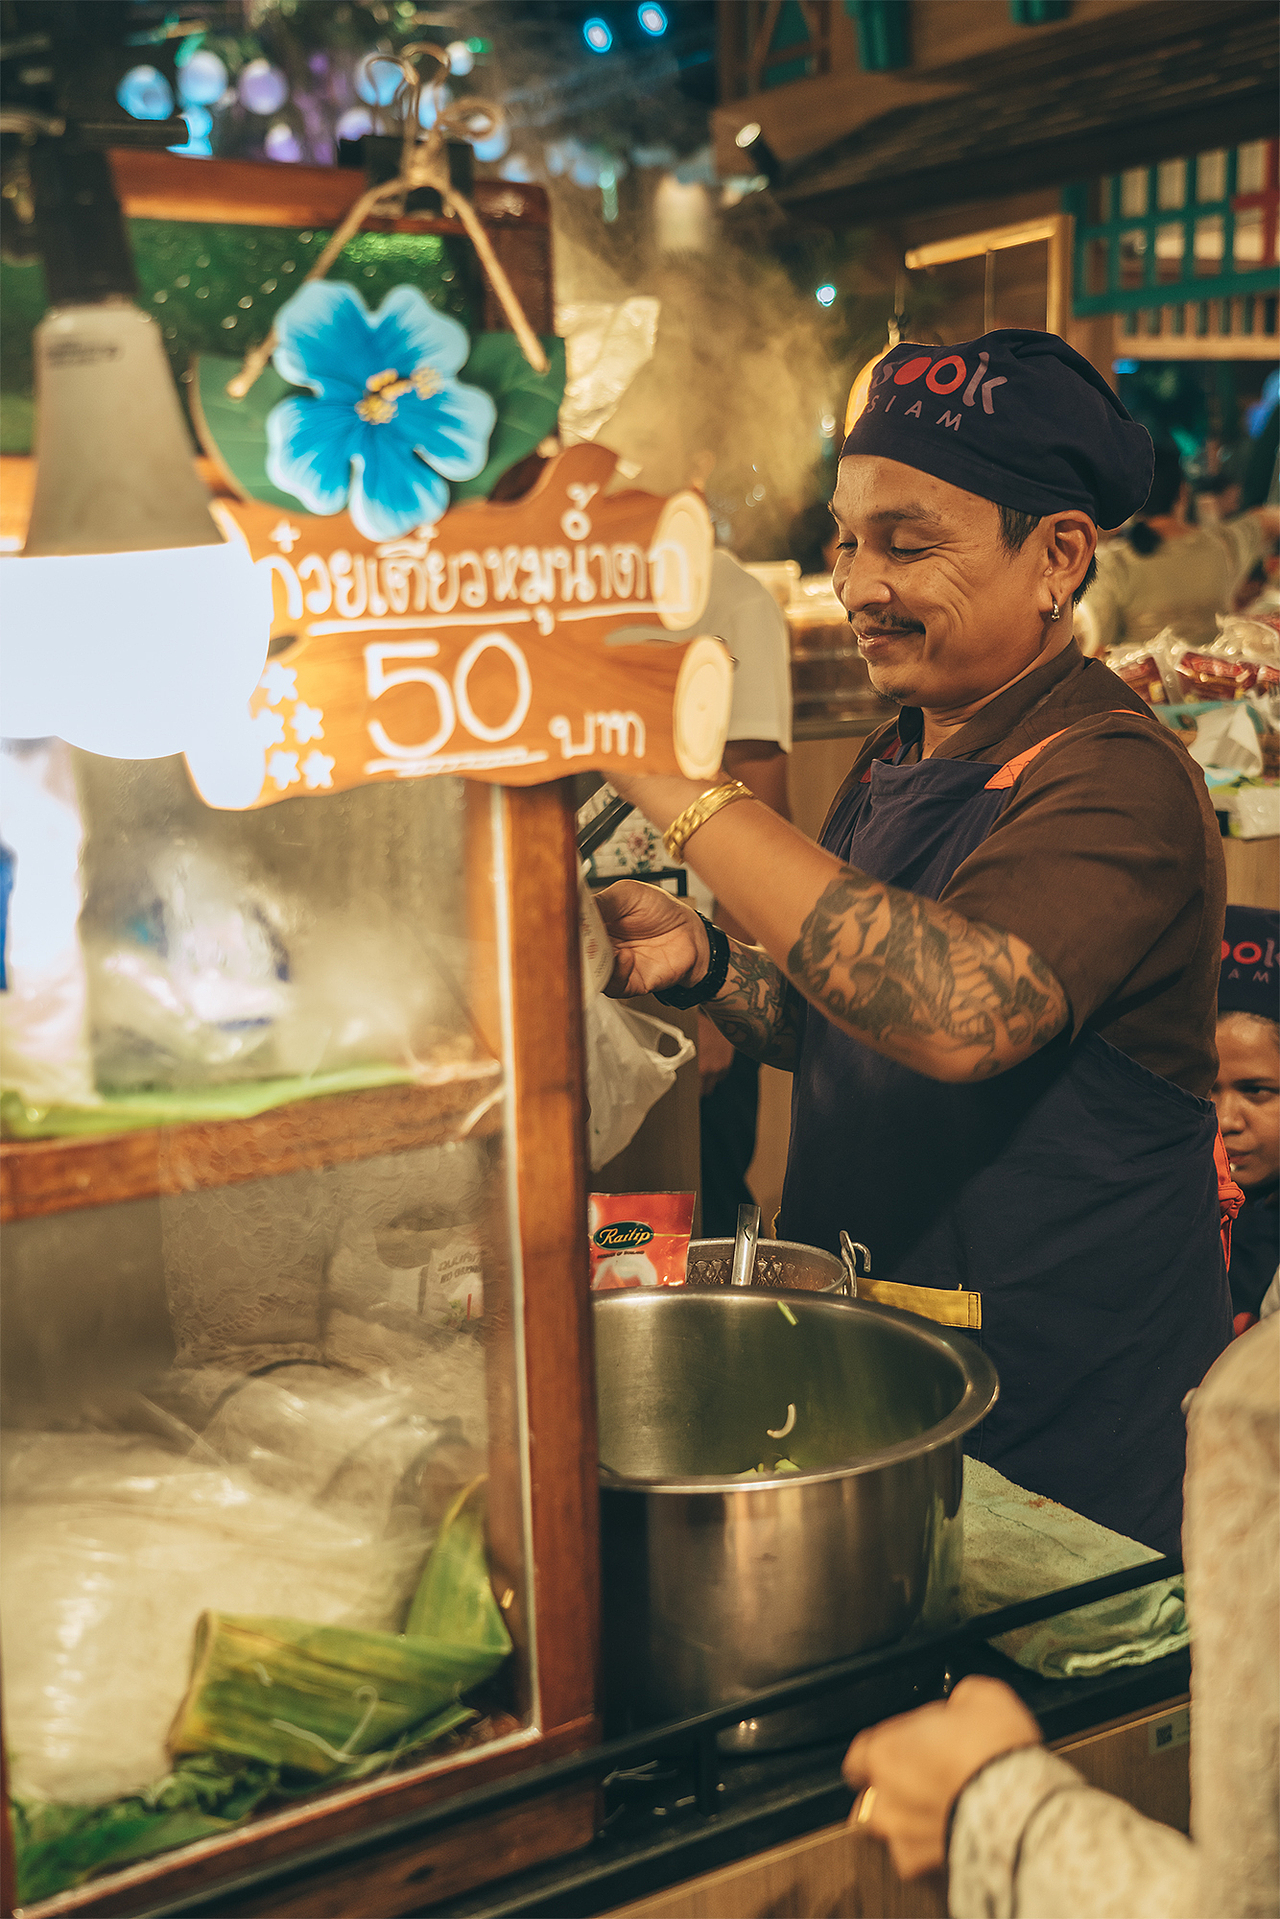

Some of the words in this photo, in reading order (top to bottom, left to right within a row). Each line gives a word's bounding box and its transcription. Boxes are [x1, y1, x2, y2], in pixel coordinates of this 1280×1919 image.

[866, 394, 962, 432] SIAM
[364, 631, 532, 760] 50
[548, 710, 646, 760] บาท
